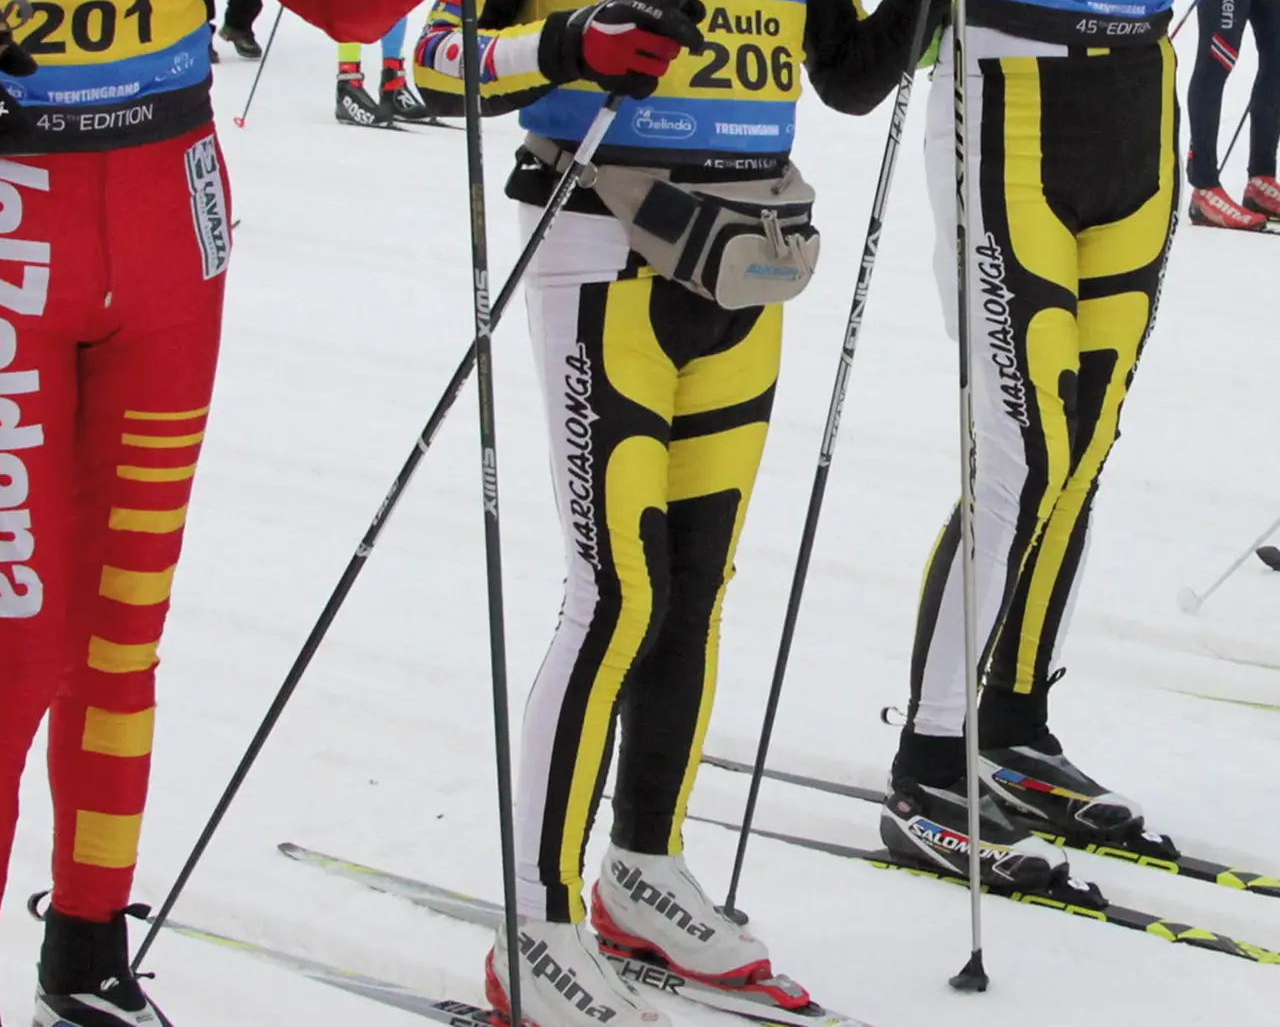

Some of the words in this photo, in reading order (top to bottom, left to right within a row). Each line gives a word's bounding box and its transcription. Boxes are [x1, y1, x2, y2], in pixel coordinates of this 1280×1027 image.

[707, 8, 780, 36] Aulo
[688, 42, 793, 92] 206
[80, 104, 153, 131] EDITION
[635, 116, 692, 132] Melinda
[204, 181, 226, 270] LAVAZZA
[565, 343, 602, 570] MARCIALONGA
[911, 821, 1011, 862] SALOMON
[611, 860, 716, 943] alpina
[517, 931, 617, 1024] alpina
